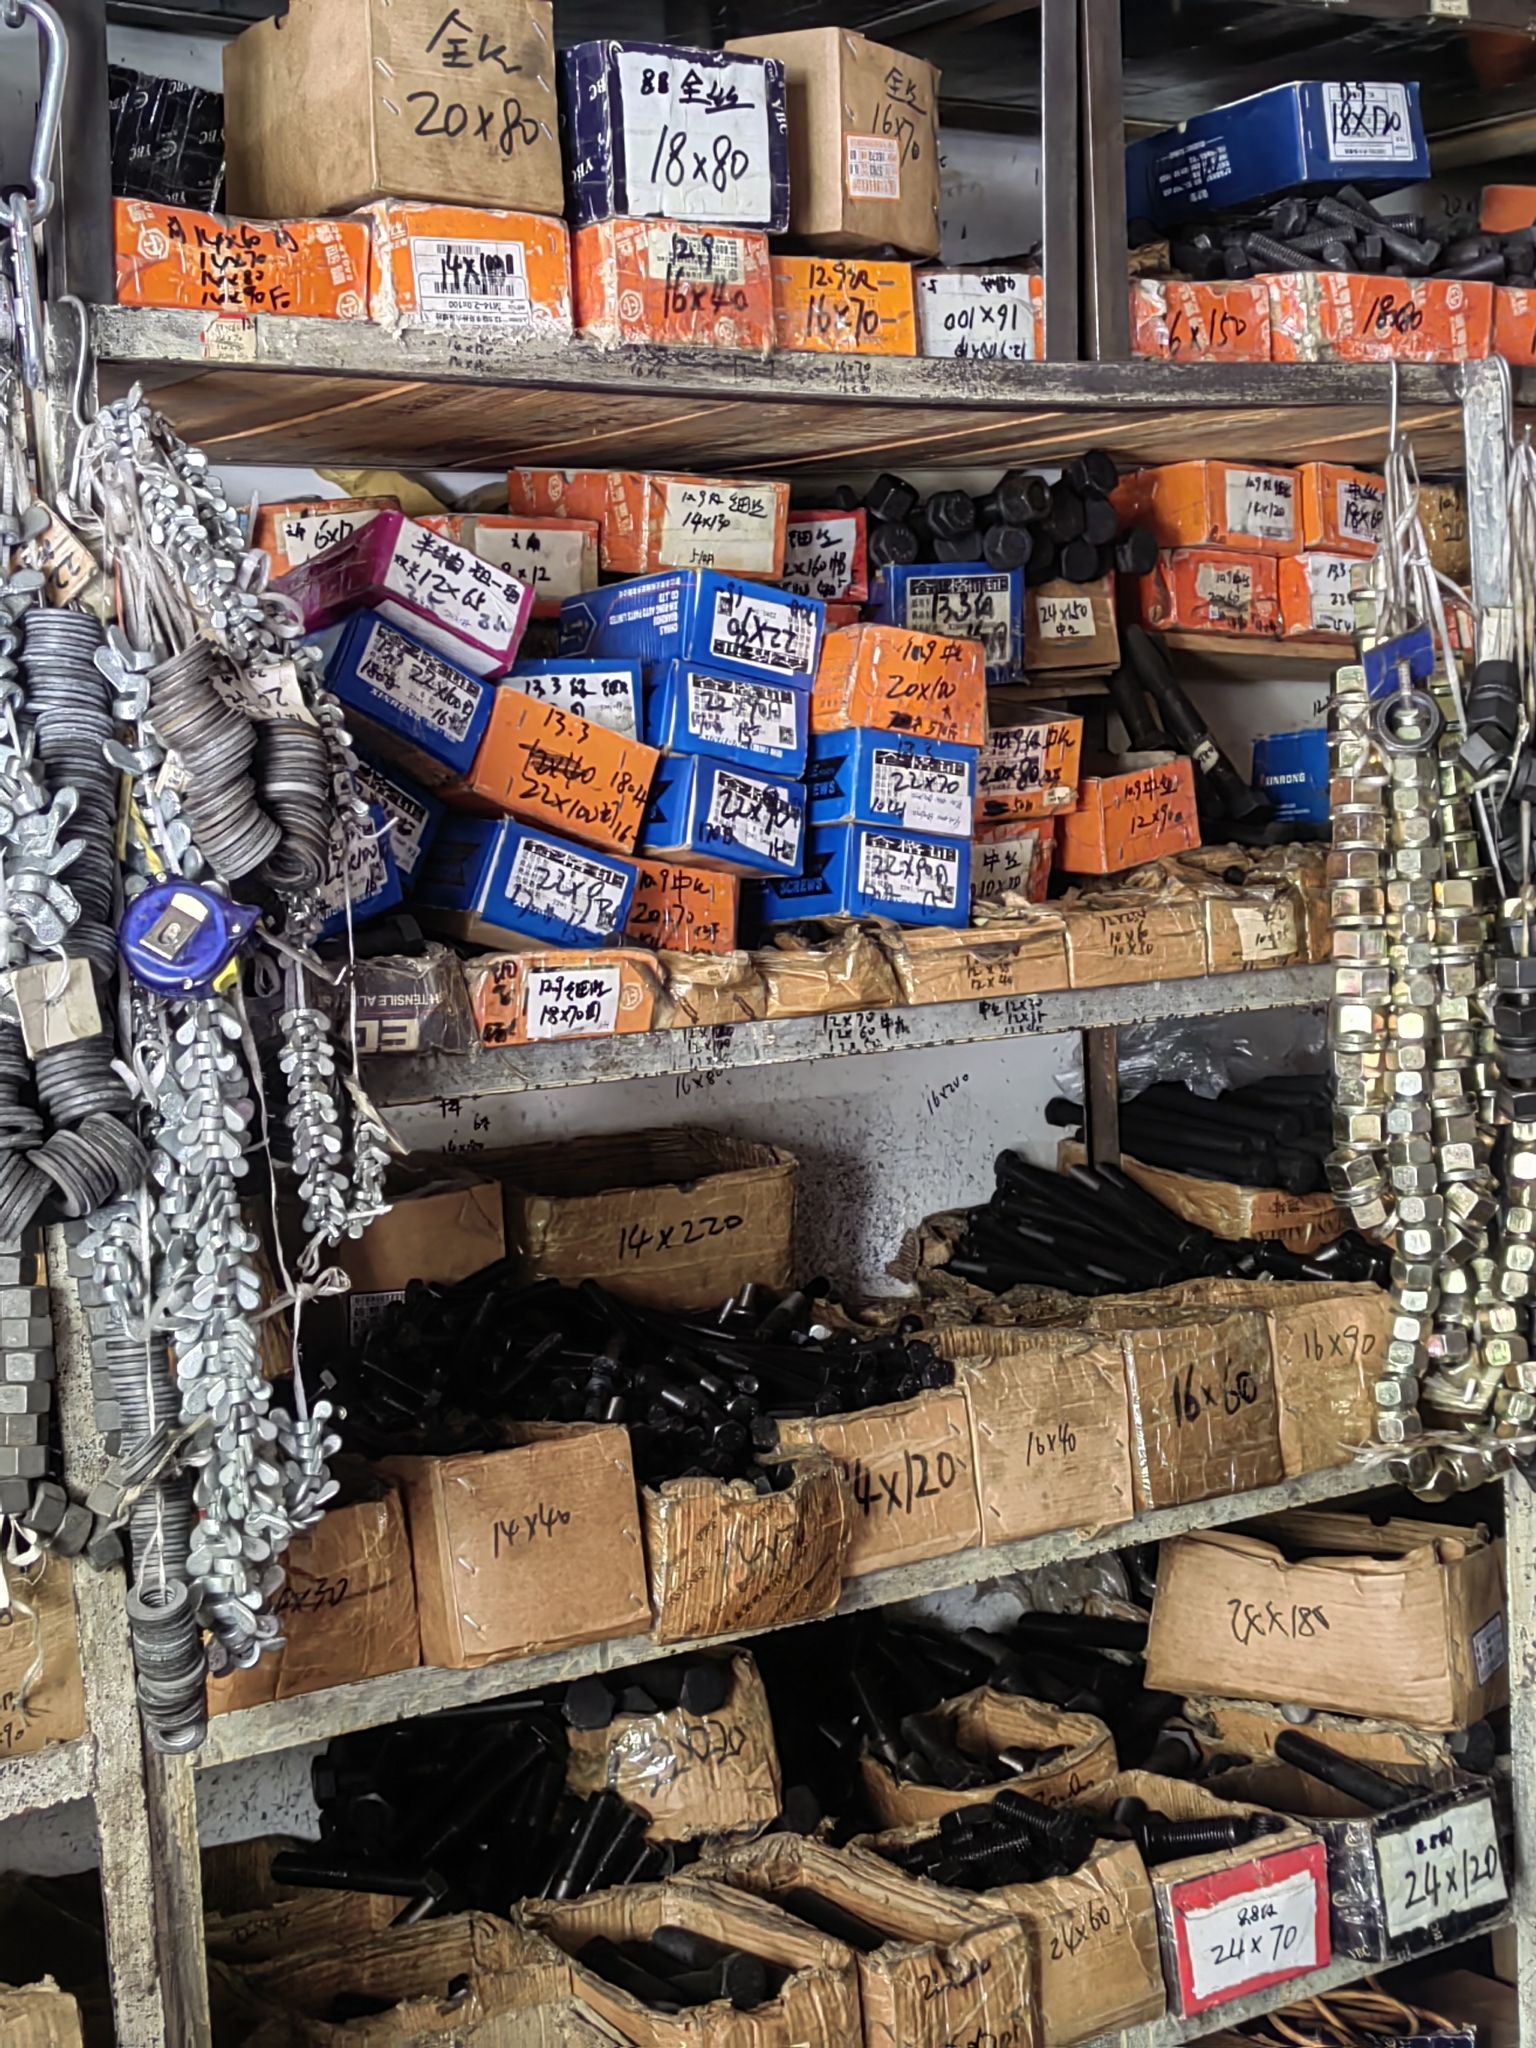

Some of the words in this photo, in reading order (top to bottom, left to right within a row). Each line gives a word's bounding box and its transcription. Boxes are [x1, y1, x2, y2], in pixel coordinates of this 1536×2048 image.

[650, 124, 750, 193] 18x80
[943, 303, 1018, 332] 16x100
[543, 708, 590, 745] 13.3
[618, 1214, 744, 1260] 14x220
[1303, 1325, 1376, 1362] 16x90
[1026, 1422, 1078, 1467] 16x40
[1405, 1844, 1498, 1910] 24x120
[1050, 1902, 1111, 1960] 24x60
[1210, 1923, 1298, 1966] 24x70
